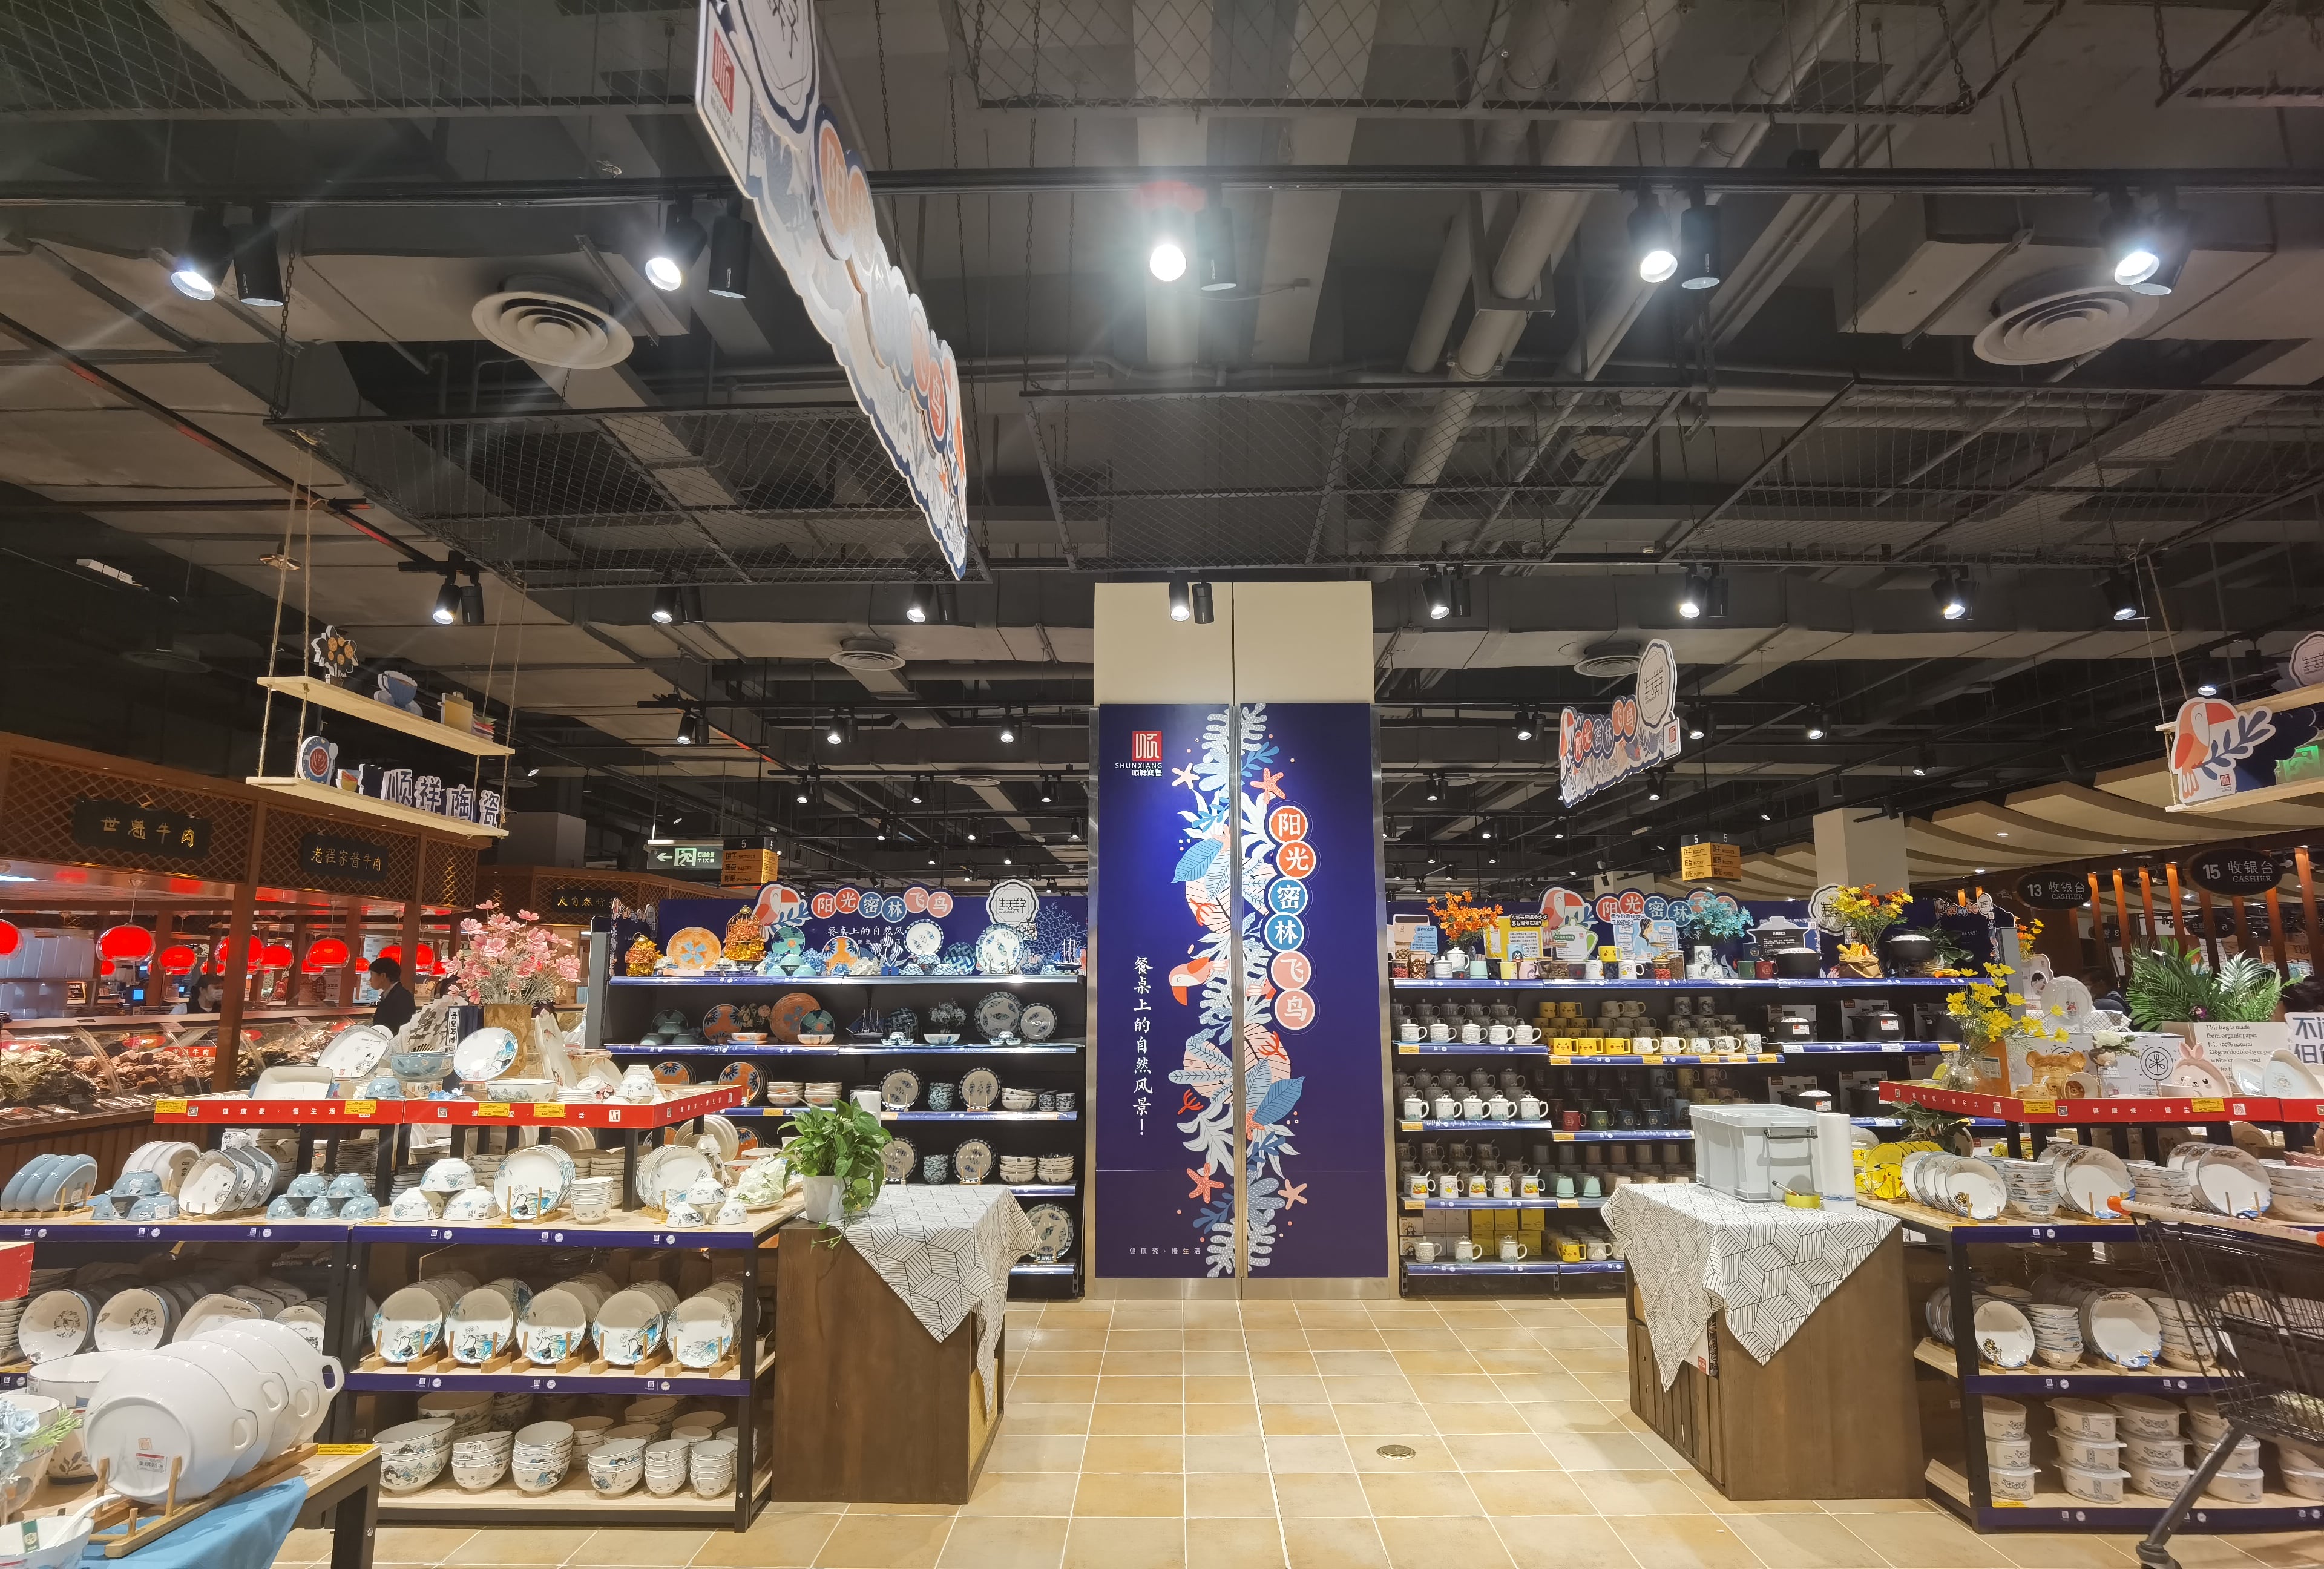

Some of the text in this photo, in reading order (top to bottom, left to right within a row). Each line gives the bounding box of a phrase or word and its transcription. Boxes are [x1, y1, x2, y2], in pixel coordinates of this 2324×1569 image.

[1575, 706, 1634, 755] 阳光密林飞鸟
[386, 769, 499, 828] 顺祥陶瓷
[741, 839, 747, 848] 5
[1694, 834, 1698, 844] 5
[1724, 833, 1728, 842] 5
[2203, 860, 2274, 879] 15 收银台
[2027, 881, 2085, 896] 13 收银台
[817, 892, 948, 916] 阳光密林飞鸟
[999, 897, 1026, 913] 生活美学
[1273, 812, 1312, 1023] 阳光密林飞鸟
